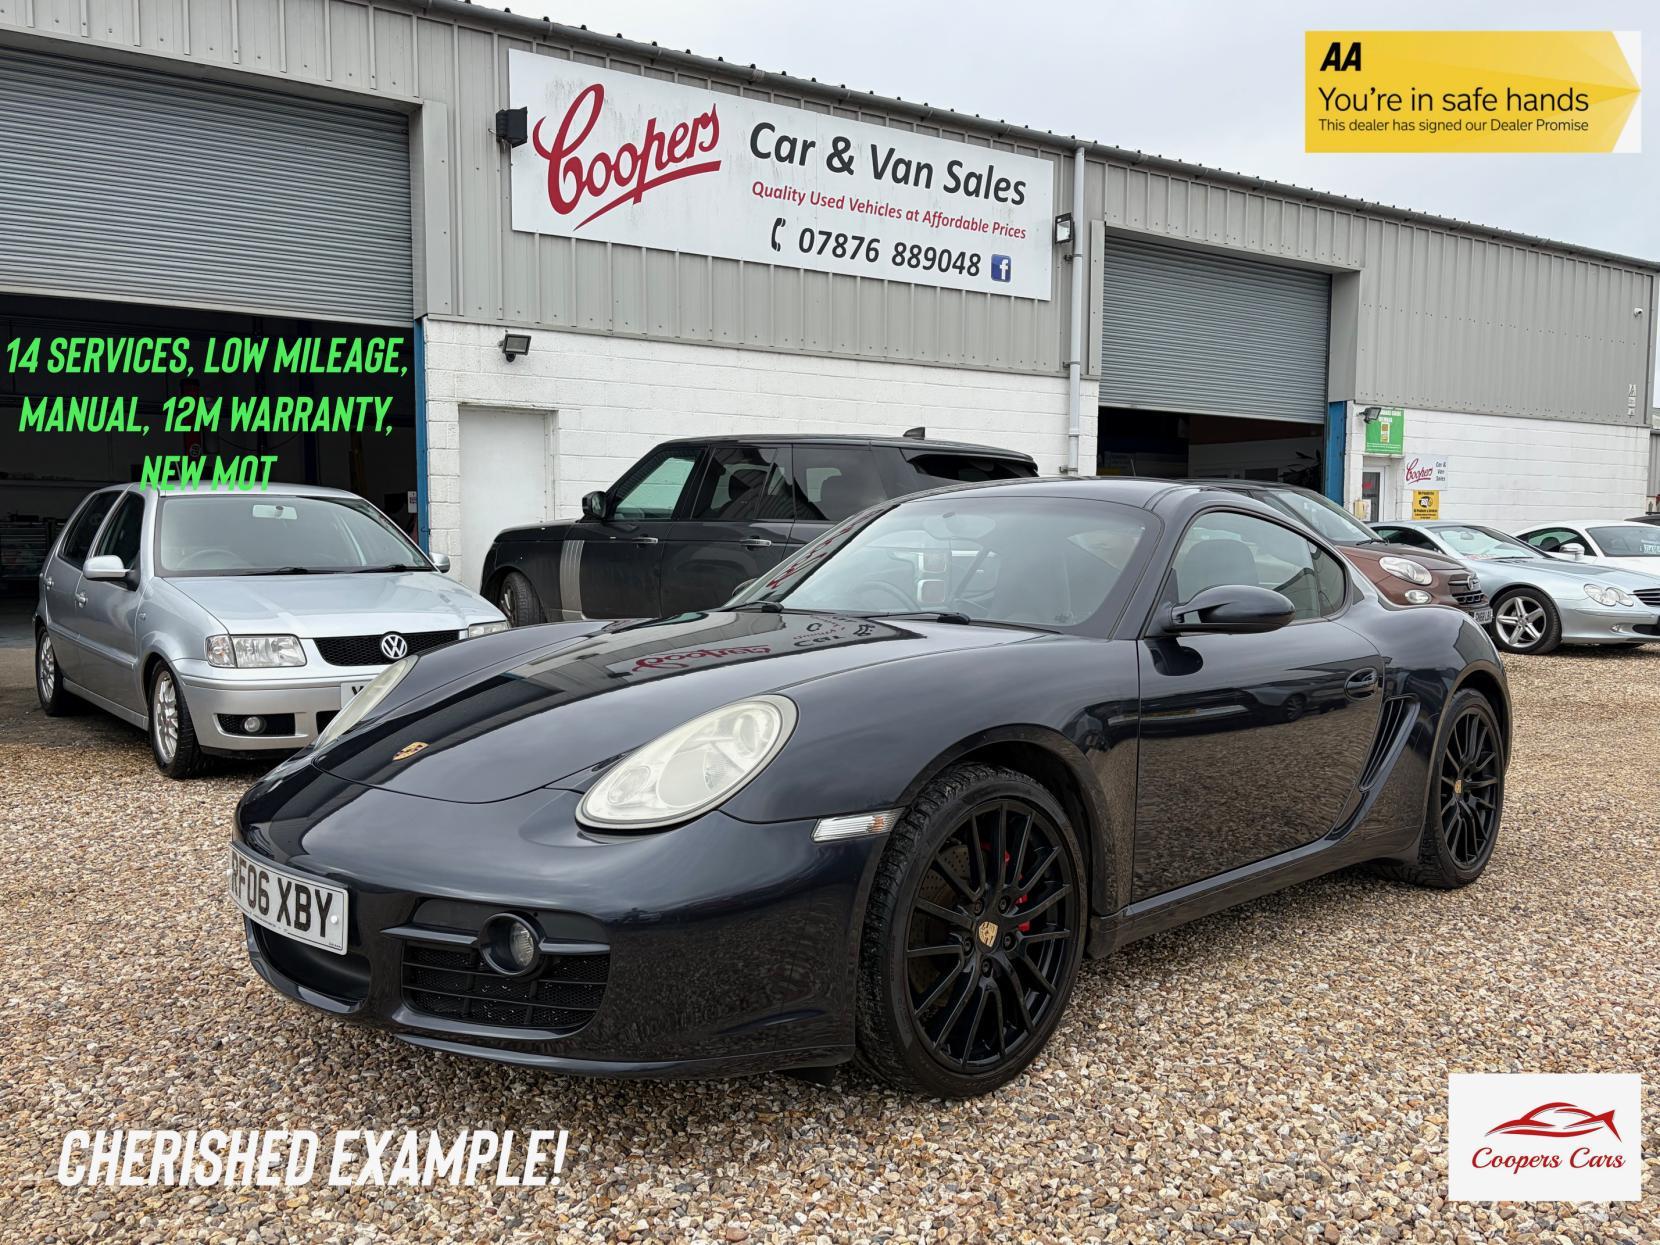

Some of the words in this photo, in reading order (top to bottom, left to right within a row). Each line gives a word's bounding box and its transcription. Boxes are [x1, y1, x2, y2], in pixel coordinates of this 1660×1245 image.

[533, 84, 721, 216] Coopers
[750, 122, 816, 166] Car
[826, 135, 855, 176] &
[870, 143, 934, 190] Van
[943, 159, 1027, 206] Sales
[752, 180, 807, 206] Quality
[810, 191, 845, 212] Used
[848, 195, 903, 222] Vehicles
[905, 209, 920, 223] at
[922, 209, 989, 235] Affordable
[992, 218, 1027, 241] Prices
[798, 227, 880, 264] 07876
[891, 241, 981, 278] 889048
[231, 850, 270, 917] RF06
[277, 877, 333, 939] XBY
